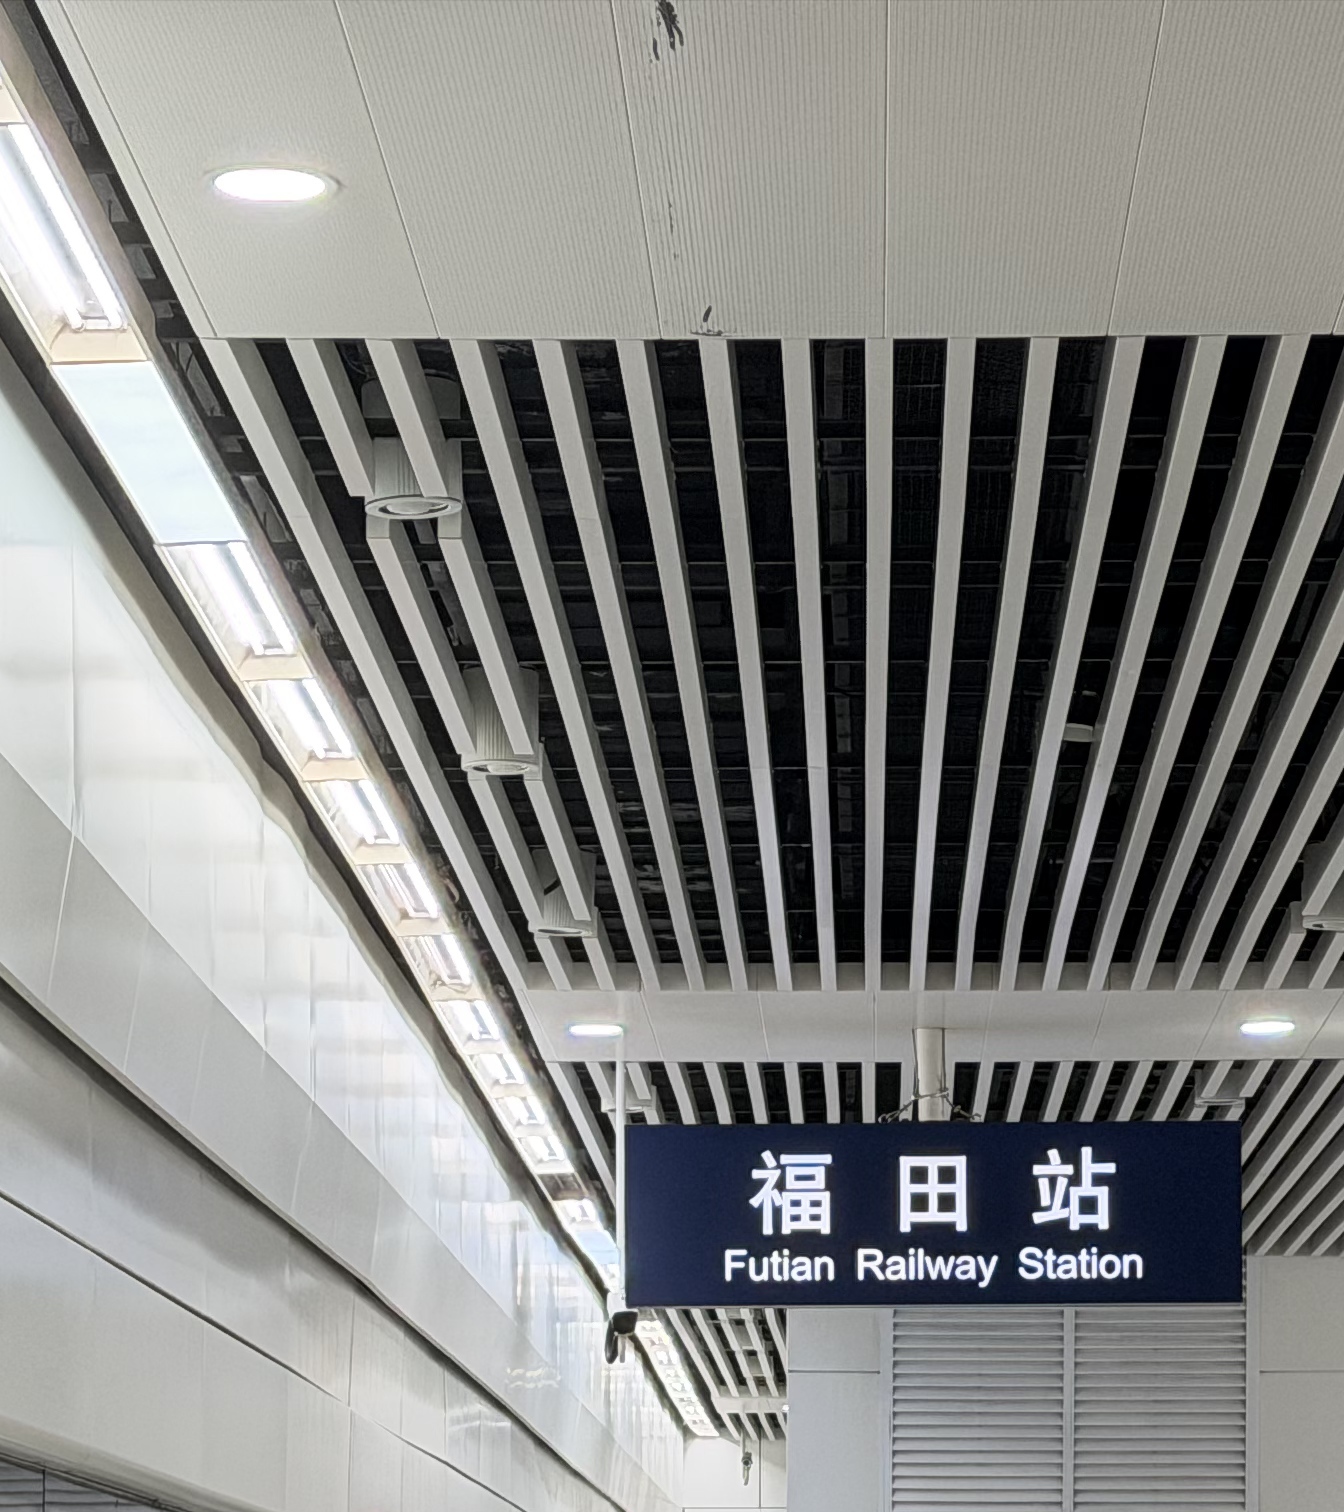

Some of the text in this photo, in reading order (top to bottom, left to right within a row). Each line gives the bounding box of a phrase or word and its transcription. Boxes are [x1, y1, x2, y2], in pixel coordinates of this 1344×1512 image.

[749, 1147, 1116, 1235] 福田站
[725, 1247, 1142, 1287] Futian Railway Station
